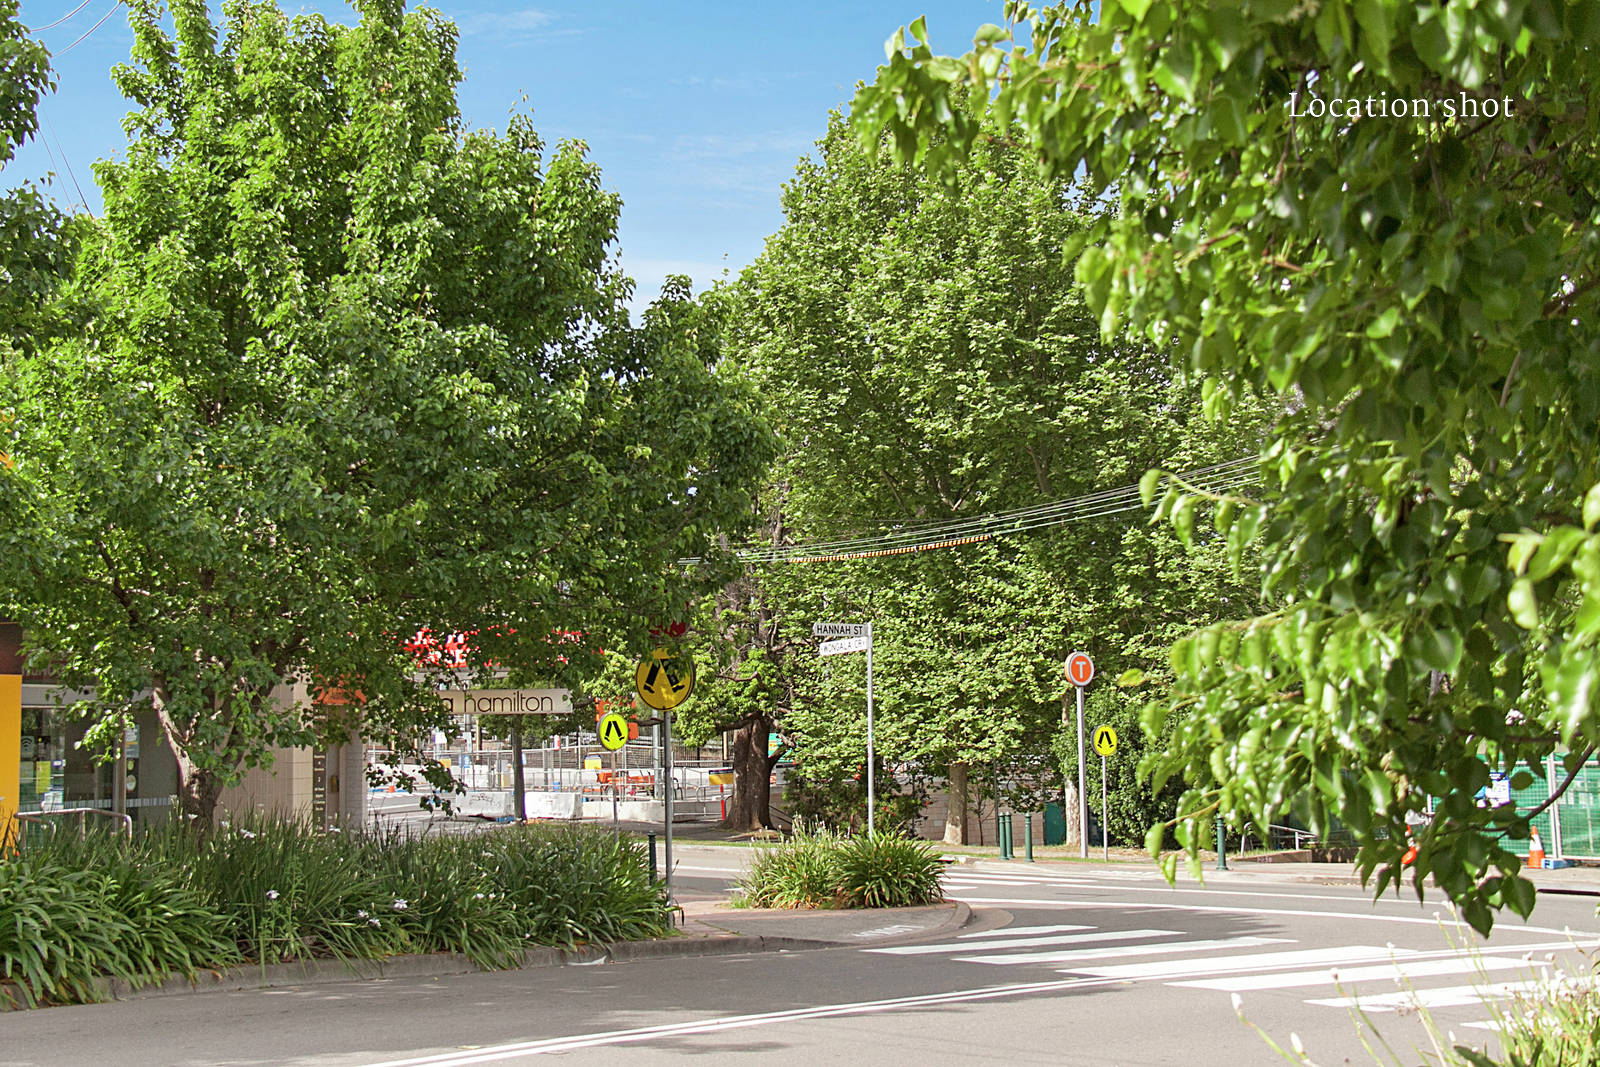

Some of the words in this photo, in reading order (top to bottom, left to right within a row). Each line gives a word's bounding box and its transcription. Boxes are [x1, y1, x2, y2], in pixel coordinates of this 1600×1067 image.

[816, 625, 851, 635] HANNAH
[853, 625, 863, 635] ST
[1076, 661, 1086, 679] T
[464, 691, 553, 712] hamilton
